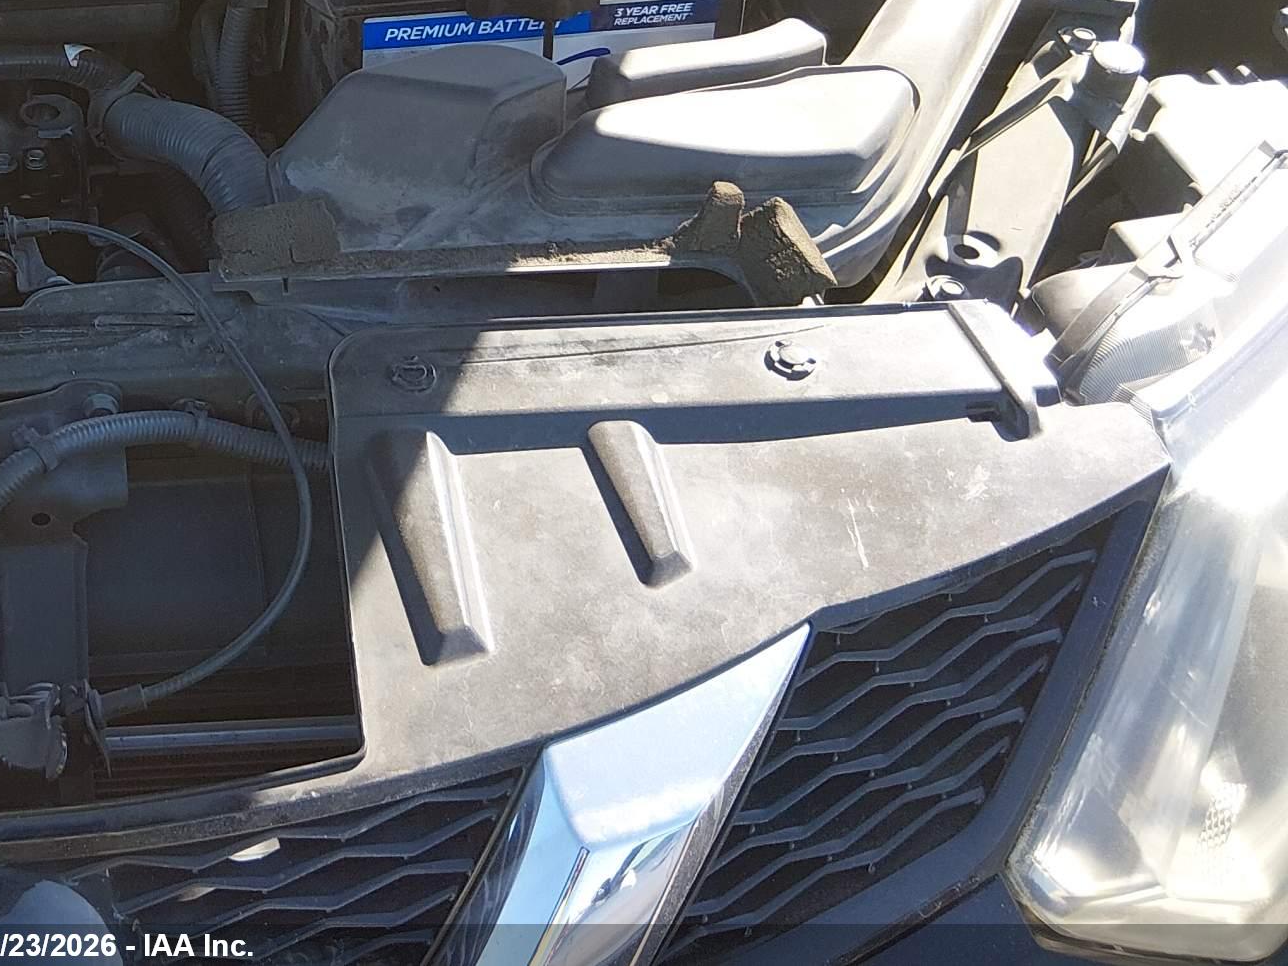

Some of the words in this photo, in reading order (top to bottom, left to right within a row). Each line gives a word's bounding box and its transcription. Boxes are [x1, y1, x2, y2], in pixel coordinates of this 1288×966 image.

[614, 7, 625, 17] 3
[626, 5, 657, 16] YEAR
[659, 2, 693, 14] FREE
[614, 13, 688, 26] REPLACEMENT
[384, 21, 475, 42] PREMIUM
[478, 17, 561, 35] BATTE
